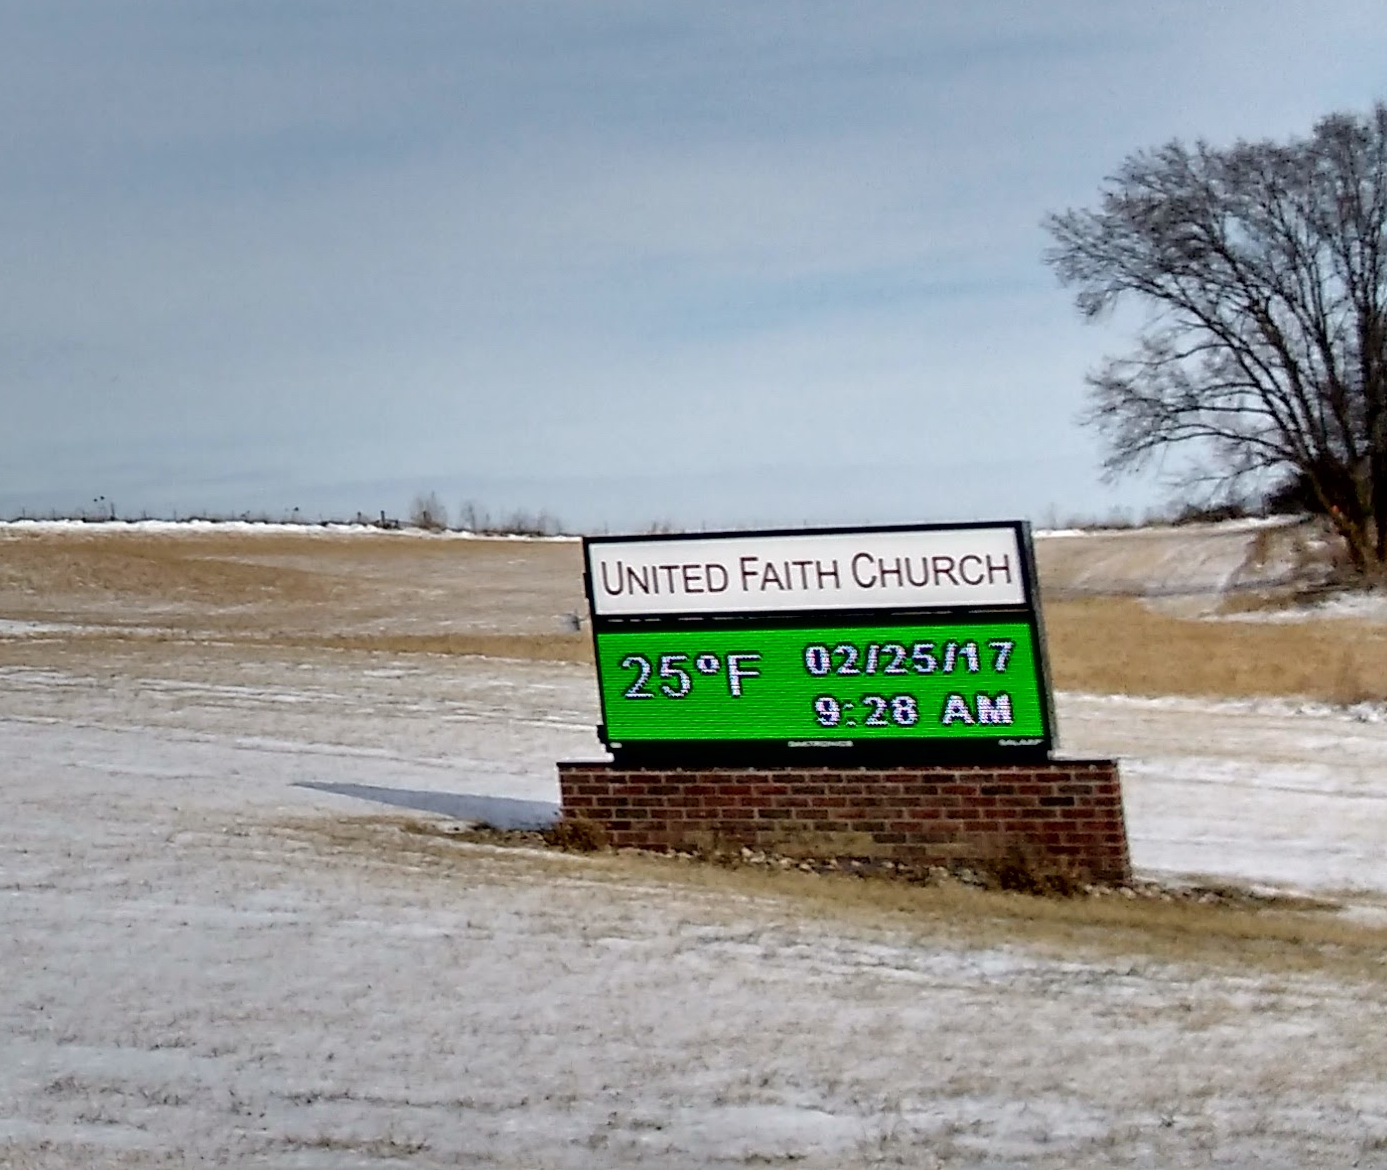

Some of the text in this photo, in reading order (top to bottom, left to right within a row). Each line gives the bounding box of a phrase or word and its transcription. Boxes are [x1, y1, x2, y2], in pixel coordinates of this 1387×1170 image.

[600, 552, 1013, 596] UNITED FAITH CHURCH
[805, 641, 1015, 675] 02/25/17
[814, 693, 1014, 726] 9:28 AM
